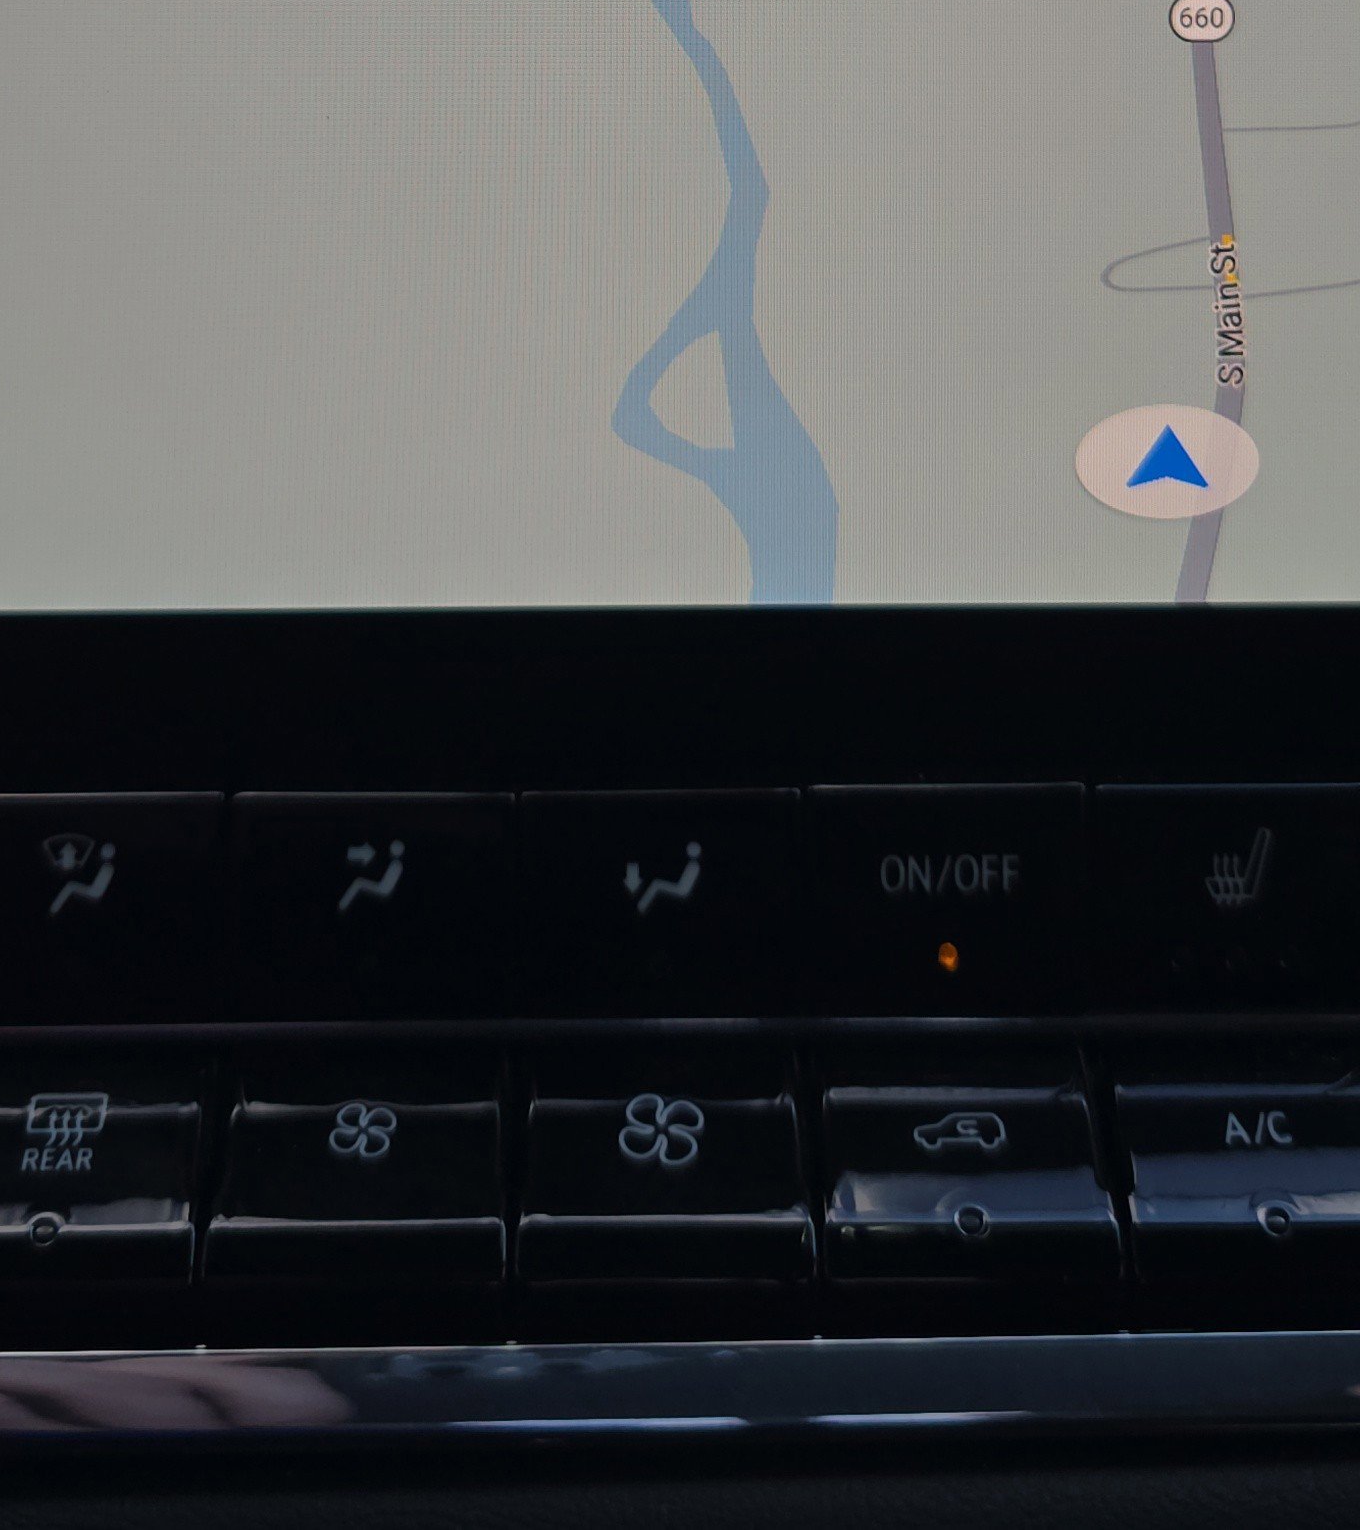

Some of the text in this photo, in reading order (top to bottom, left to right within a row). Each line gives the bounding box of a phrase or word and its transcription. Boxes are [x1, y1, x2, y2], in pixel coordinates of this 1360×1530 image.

[1178, 6, 1226, 30] 660
[1210, 241, 1245, 386] S Main St
[879, 853, 1020, 895] ON/OFF
[1225, 1111, 1293, 1146] A/C
[21, 1148, 93, 1173] REAR
